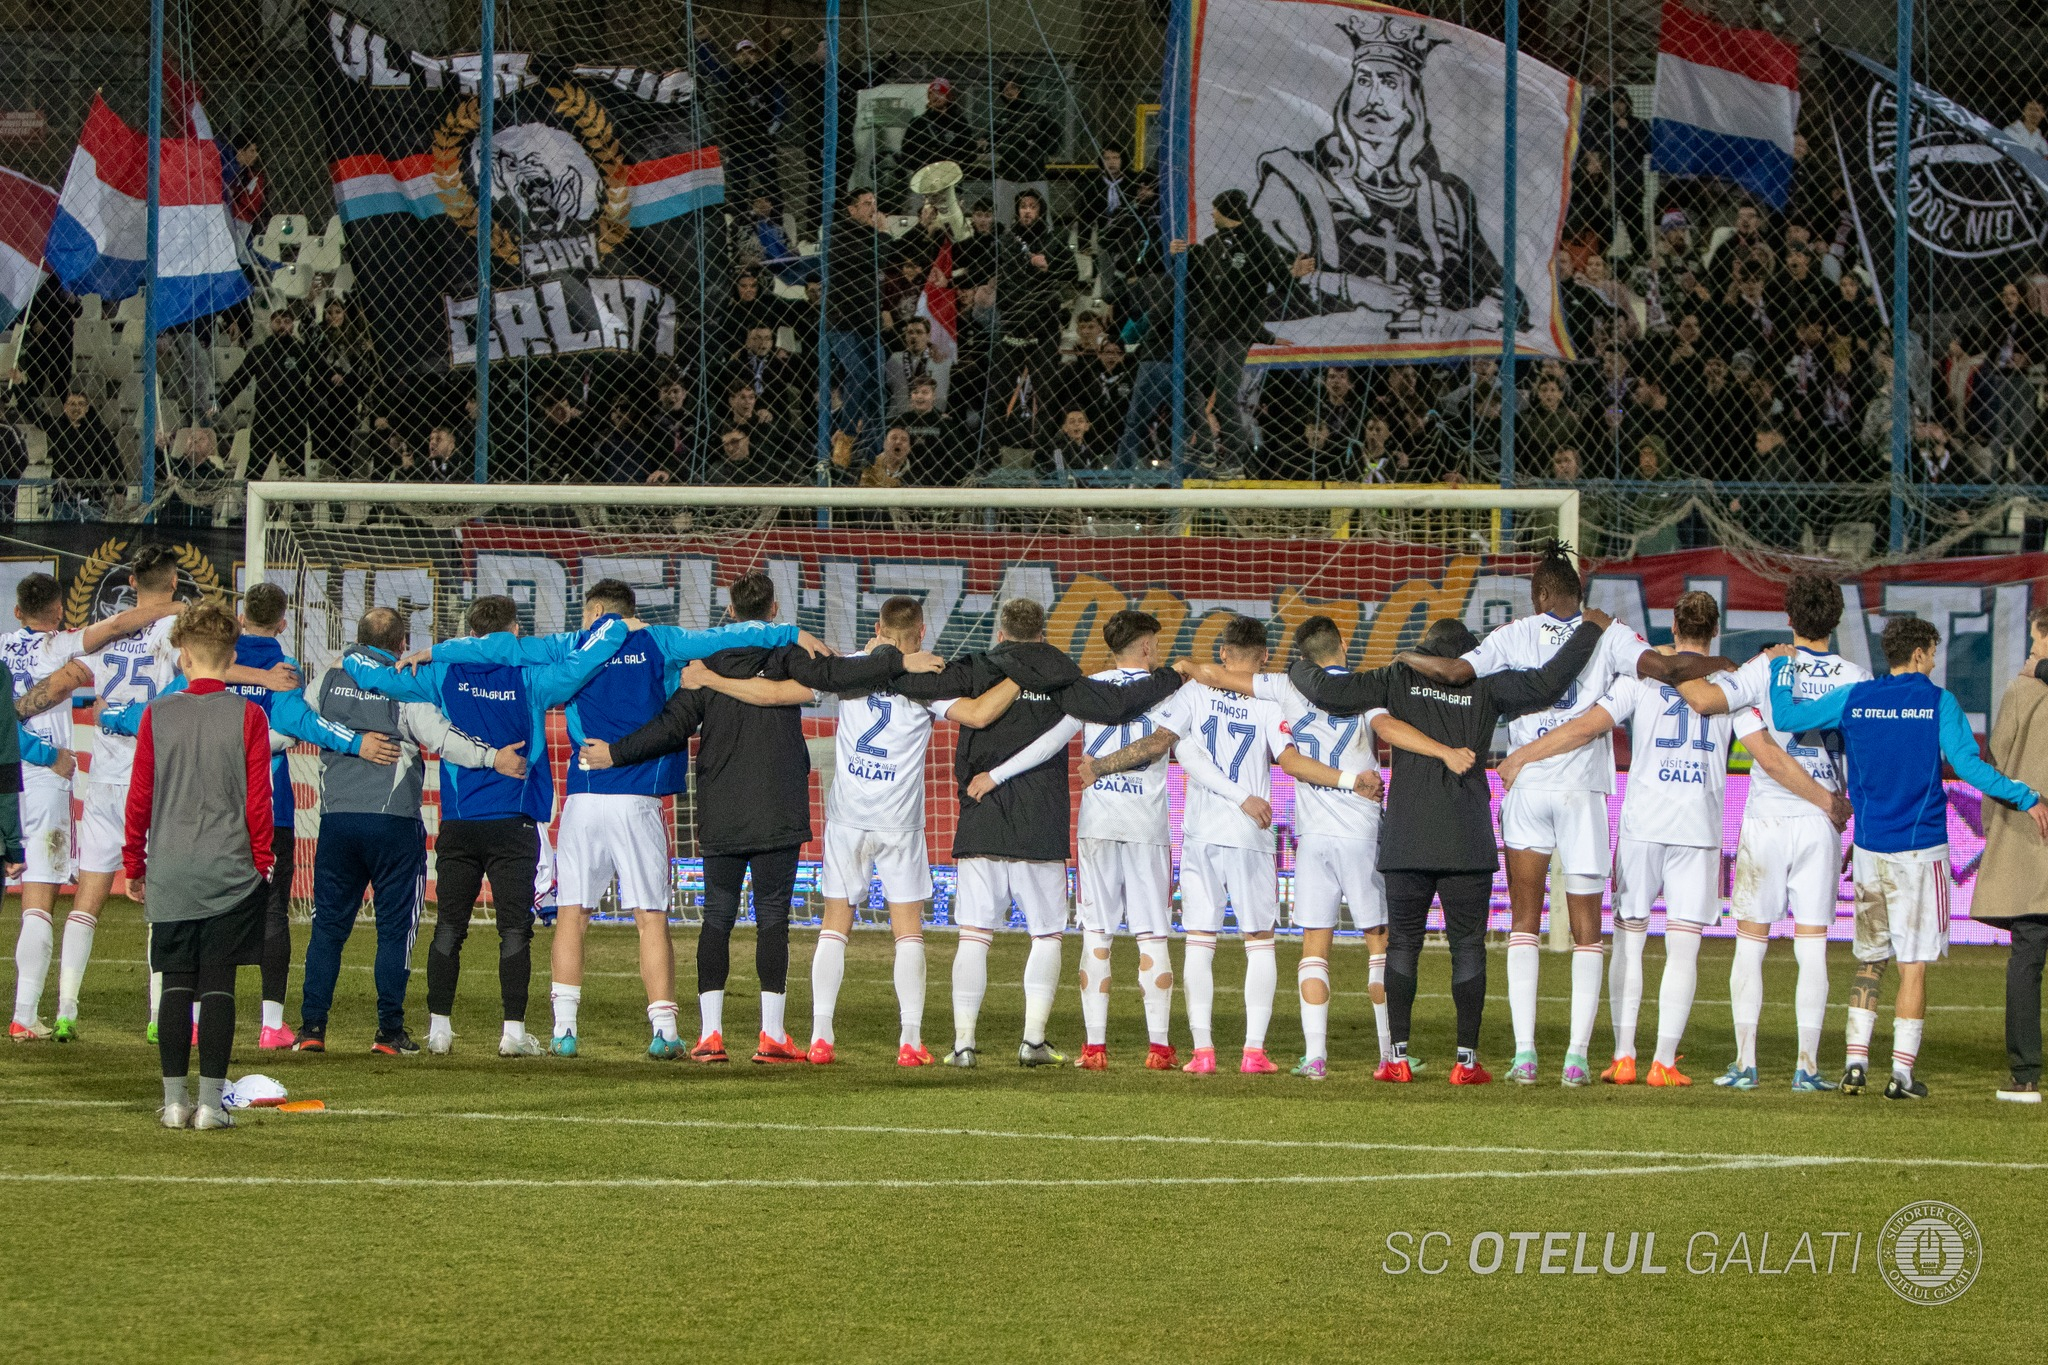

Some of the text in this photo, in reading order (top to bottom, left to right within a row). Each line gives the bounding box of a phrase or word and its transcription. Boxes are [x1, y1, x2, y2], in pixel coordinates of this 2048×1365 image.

[1965, 209, 2013, 246] DIN
[521, 232, 600, 276] 2004
[445, 276, 677, 366] GALATI
[101, 654, 157, 708] 25
[241, 686, 267, 697] GALAT
[458, 682, 470, 692] SC
[855, 695, 892, 758] 2
[1655, 685, 1716, 753] 31
[1851, 708, 1934, 720] SC OTELUL GALATI
[1200, 714, 1257, 783] 17
[1291, 711, 1359, 770] 67
[848, 762, 896, 781] GALATI
[1658, 768, 1707, 788] GALA
[1659, 757, 1682, 769] visit
[1093, 779, 1144, 795] GALATI
